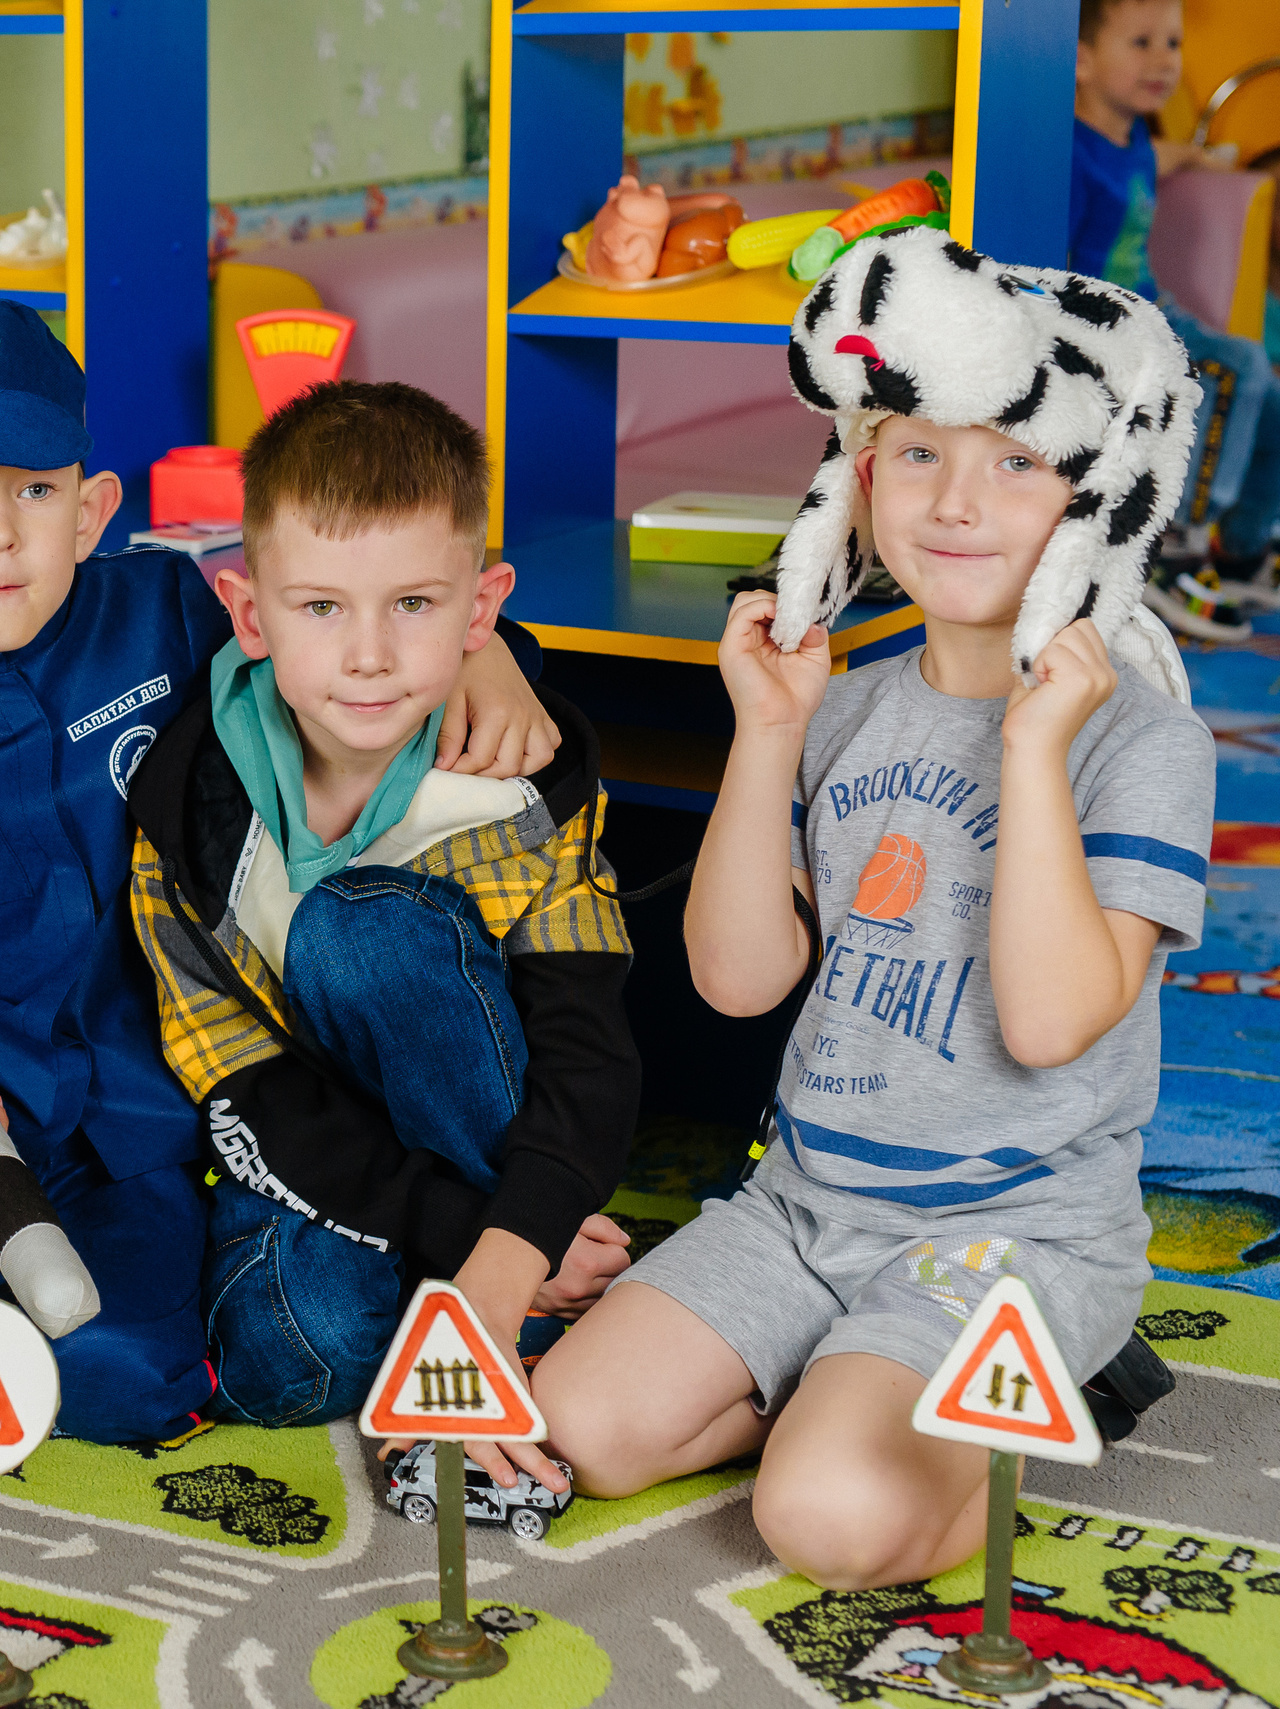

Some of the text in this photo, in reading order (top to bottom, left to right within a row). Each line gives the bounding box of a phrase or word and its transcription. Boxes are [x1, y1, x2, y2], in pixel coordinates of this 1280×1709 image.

[73, 681, 166, 736] КАПИТАН ДПС
[828, 758, 979, 821] BROOKLYN
[952, 901, 971, 920] CO.
[815, 935, 975, 1063] ETBALL
[799, 1068, 888, 1095] STARS TEAM
